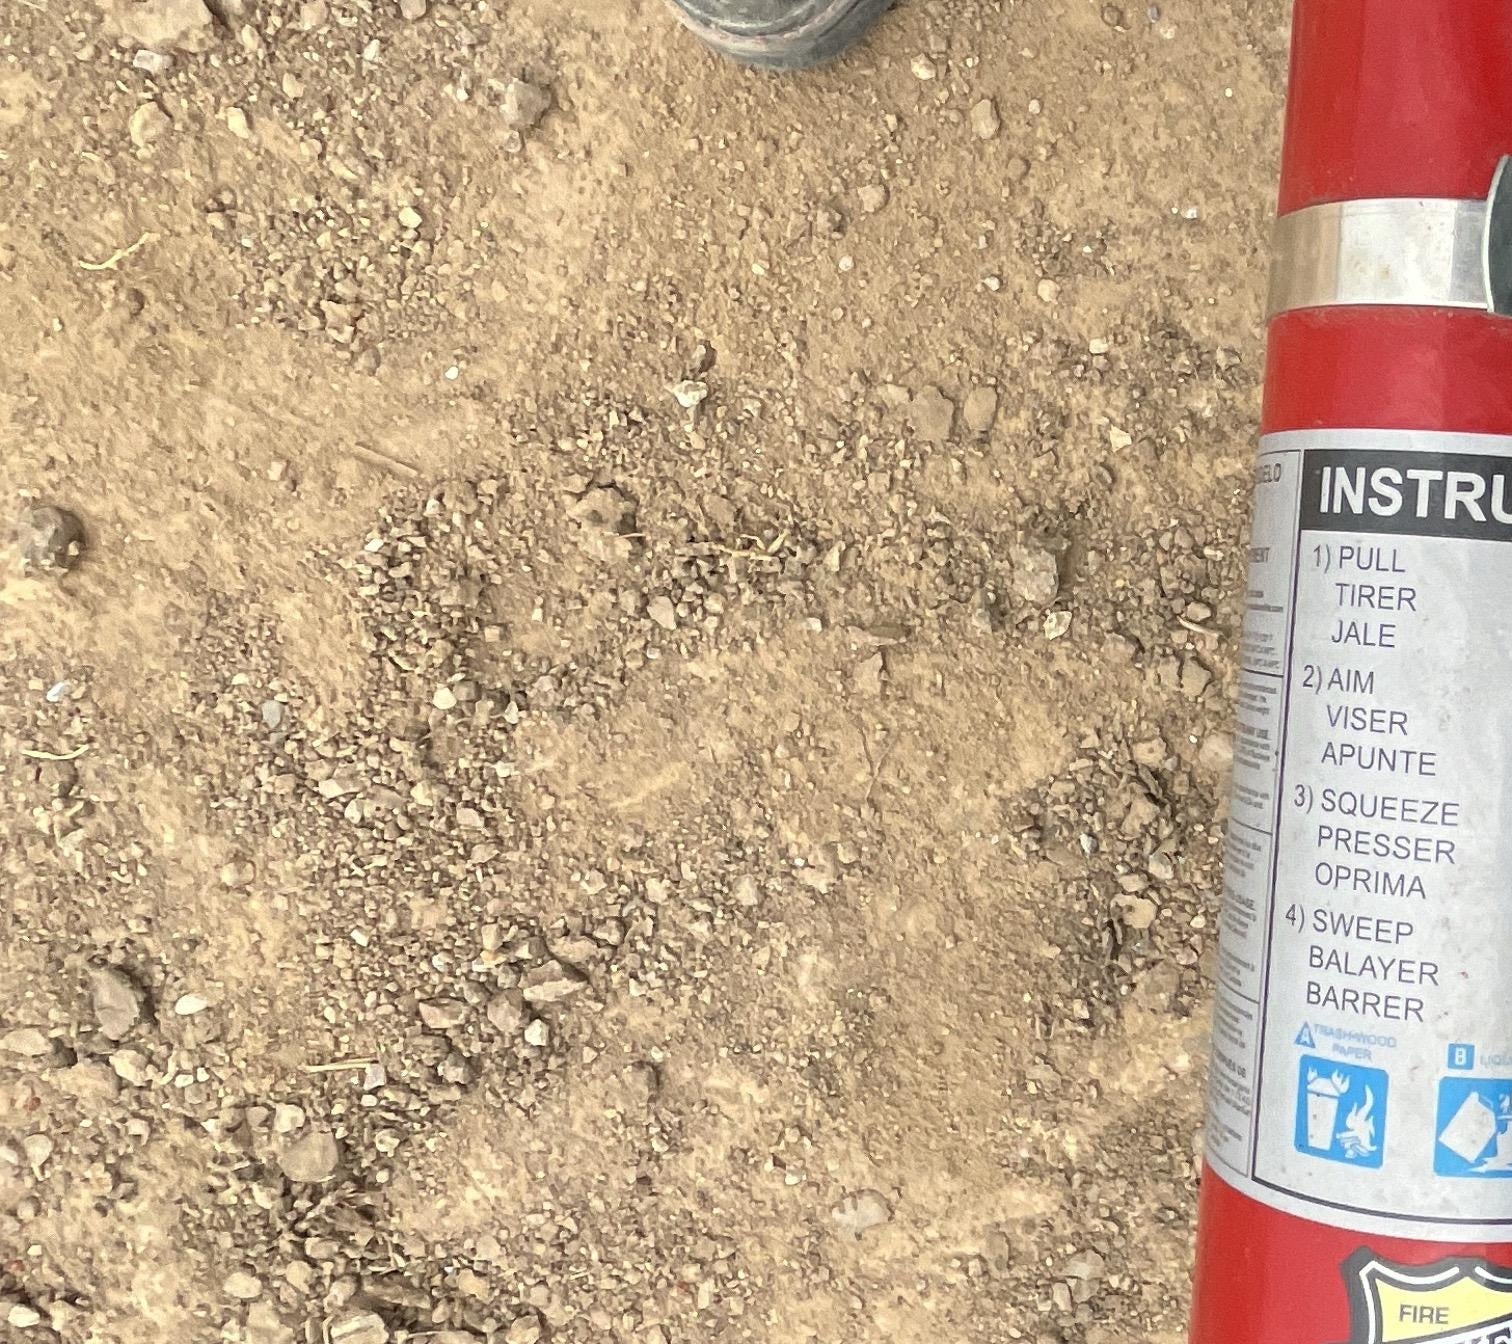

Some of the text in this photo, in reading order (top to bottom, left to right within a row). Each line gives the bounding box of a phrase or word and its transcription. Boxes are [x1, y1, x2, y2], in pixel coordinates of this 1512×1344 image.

[1312, 545, 1406, 574] 1) PULL
[1334, 583, 1417, 612] TIRER
[1330, 620, 1396, 650] JALE
[1302, 665, 1374, 696] 2) AIM
[1325, 706, 1409, 736] VISER
[1320, 742, 1437, 776] APUNTE
[1294, 784, 1314, 814] 3)
[1320, 788, 1460, 828] SQUEEZE
[1316, 825, 1456, 865] PRESSER
[1314, 862, 1426, 900] OPRIMA
[1284, 906, 1304, 934] 4)
[1312, 908, 1414, 946] SWEEP
[1308, 944, 1440, 986] BALAYER
[1305, 985, 1424, 1022] BARRER
[1399, 1304, 1450, 1326] FIRE
